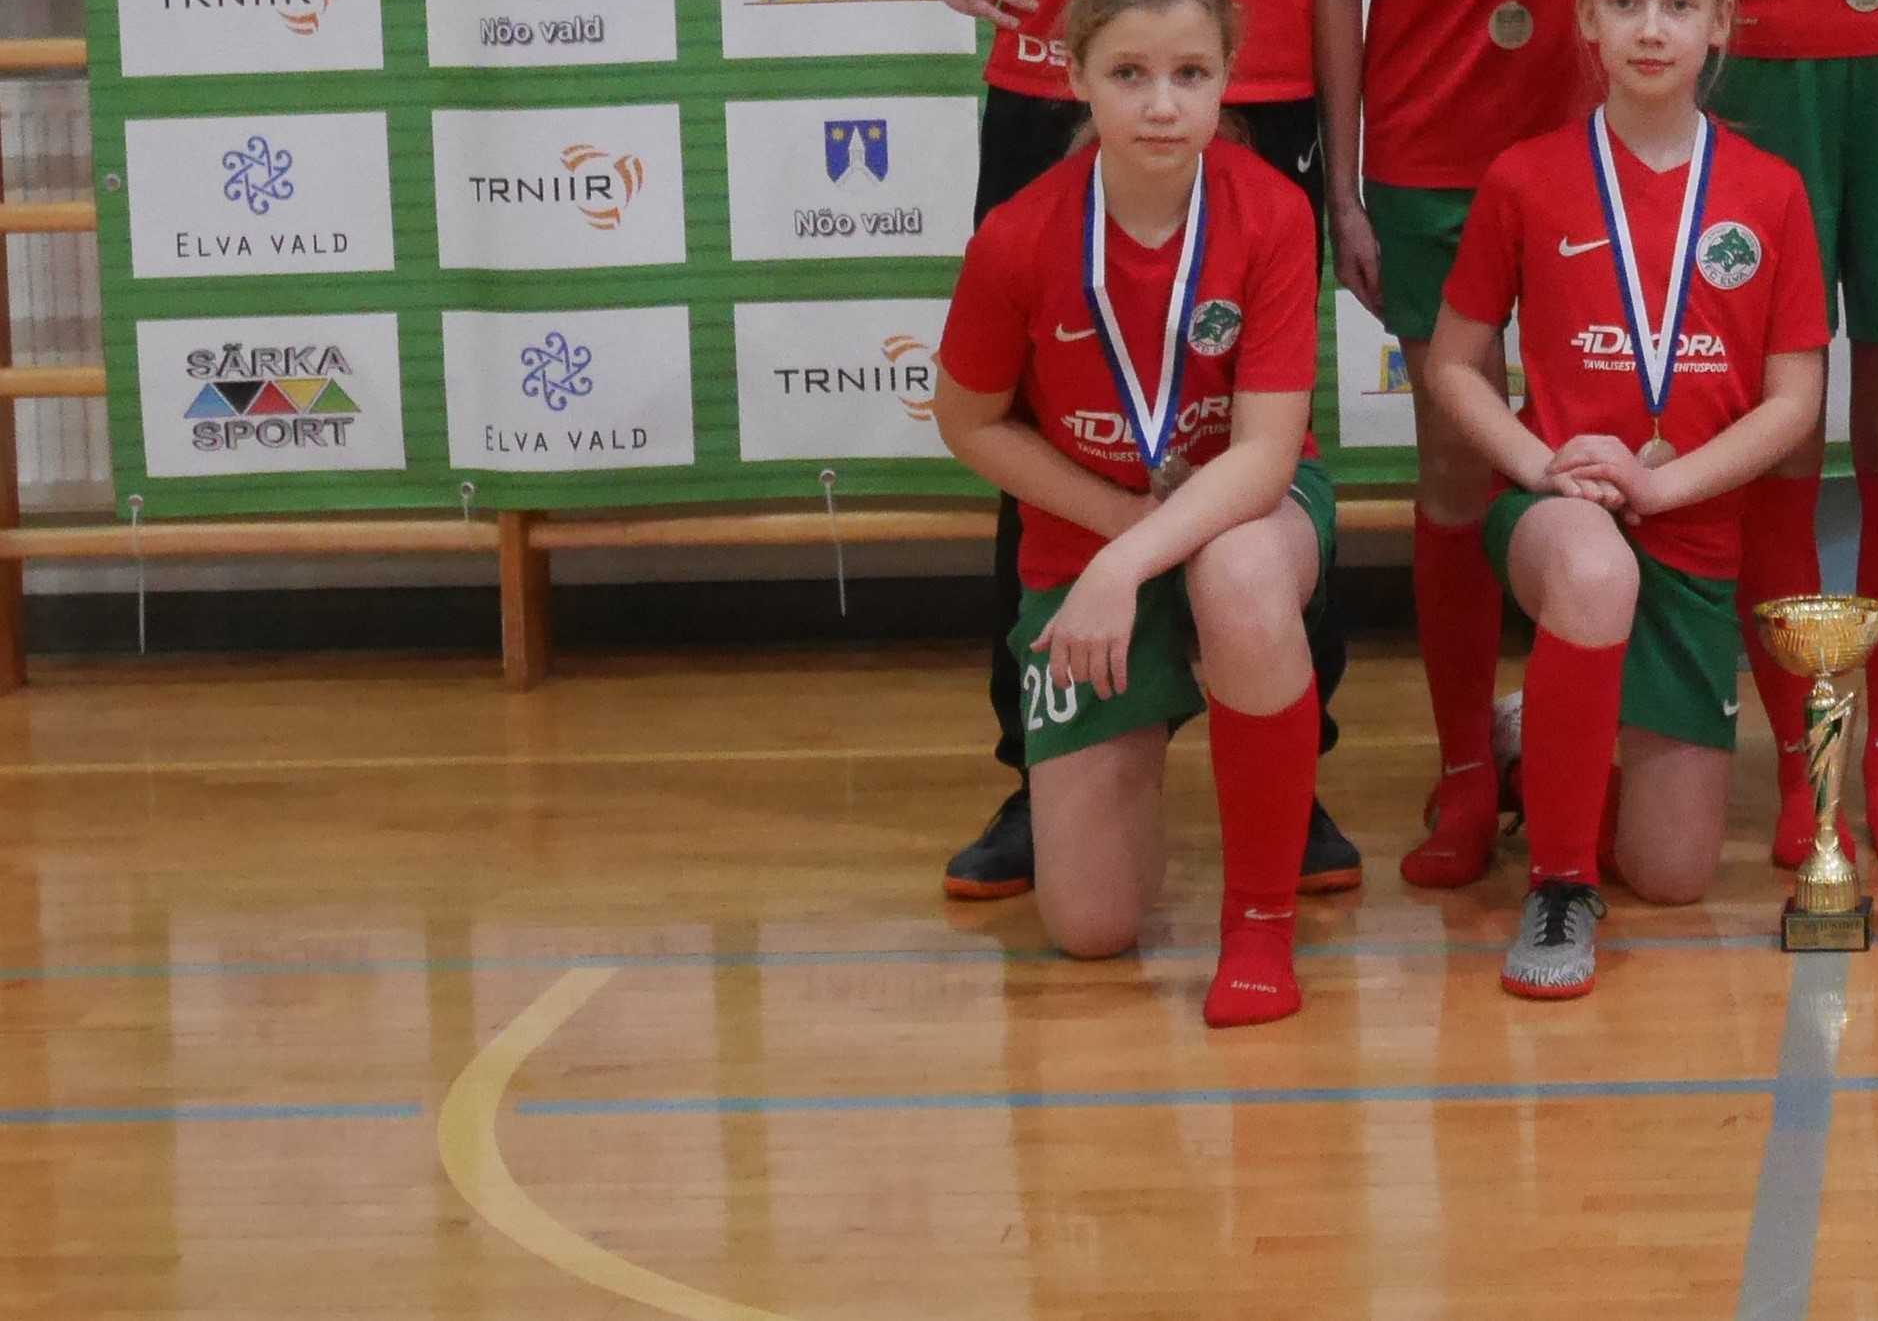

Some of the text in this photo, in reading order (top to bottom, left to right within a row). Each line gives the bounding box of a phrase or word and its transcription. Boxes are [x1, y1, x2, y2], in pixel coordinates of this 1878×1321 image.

[480, 14, 605, 46] Nõo vald
[469, 174, 613, 203] TRNIIR
[795, 208, 923, 238] Nõo vald
[177, 232, 348, 258] ELVA VALD
[1571, 324, 1726, 357] DORA
[186, 344, 353, 379] SÄRKA
[773, 365, 930, 395] TRNIIR
[192, 416, 355, 452] SPORT
[1061, 395, 1231, 445] DOR
[485, 426, 648, 453] ELVA VALD
[1022, 664, 1077, 731] 20
